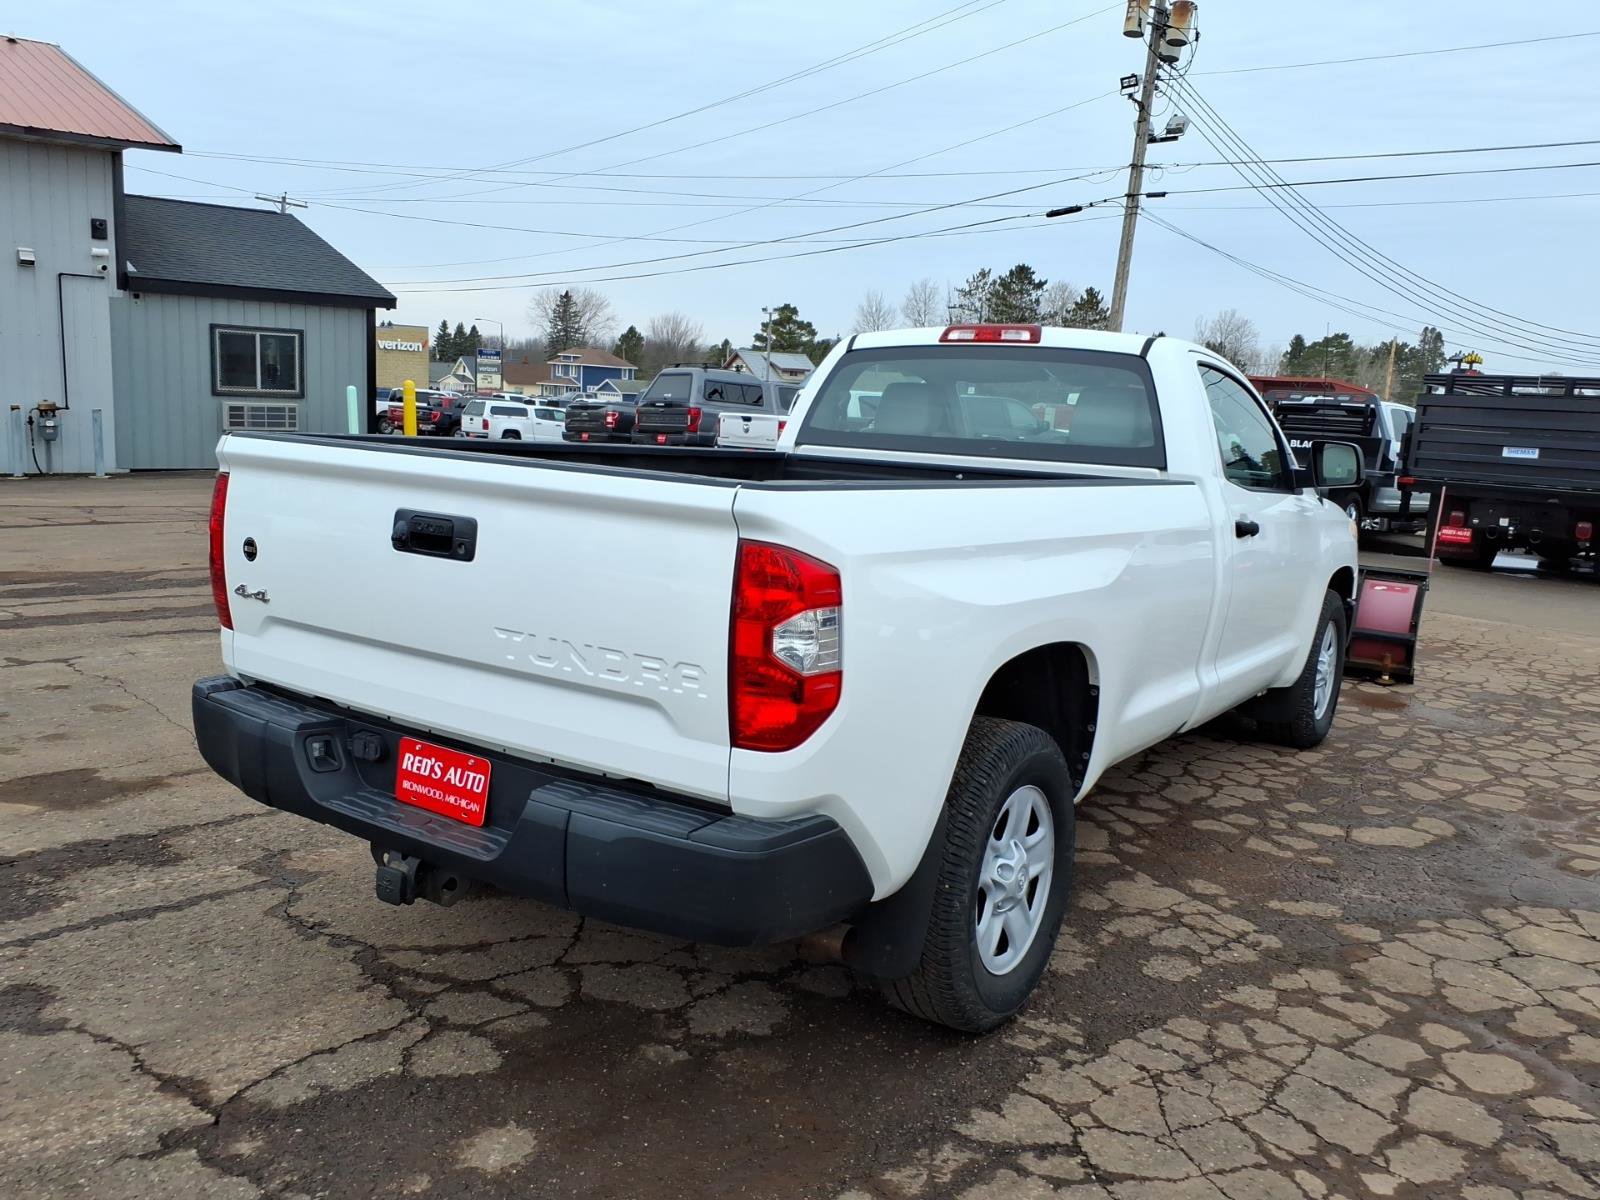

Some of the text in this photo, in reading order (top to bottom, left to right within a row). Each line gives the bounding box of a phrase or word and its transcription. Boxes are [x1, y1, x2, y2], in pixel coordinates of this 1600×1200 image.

[378, 339, 422, 351] verizon
[493, 626, 708, 699] TUNDRA
[402, 752, 485, 793] RED'S AUTO
[402, 779, 480, 813] IRONWOOD, MICHIGAN
